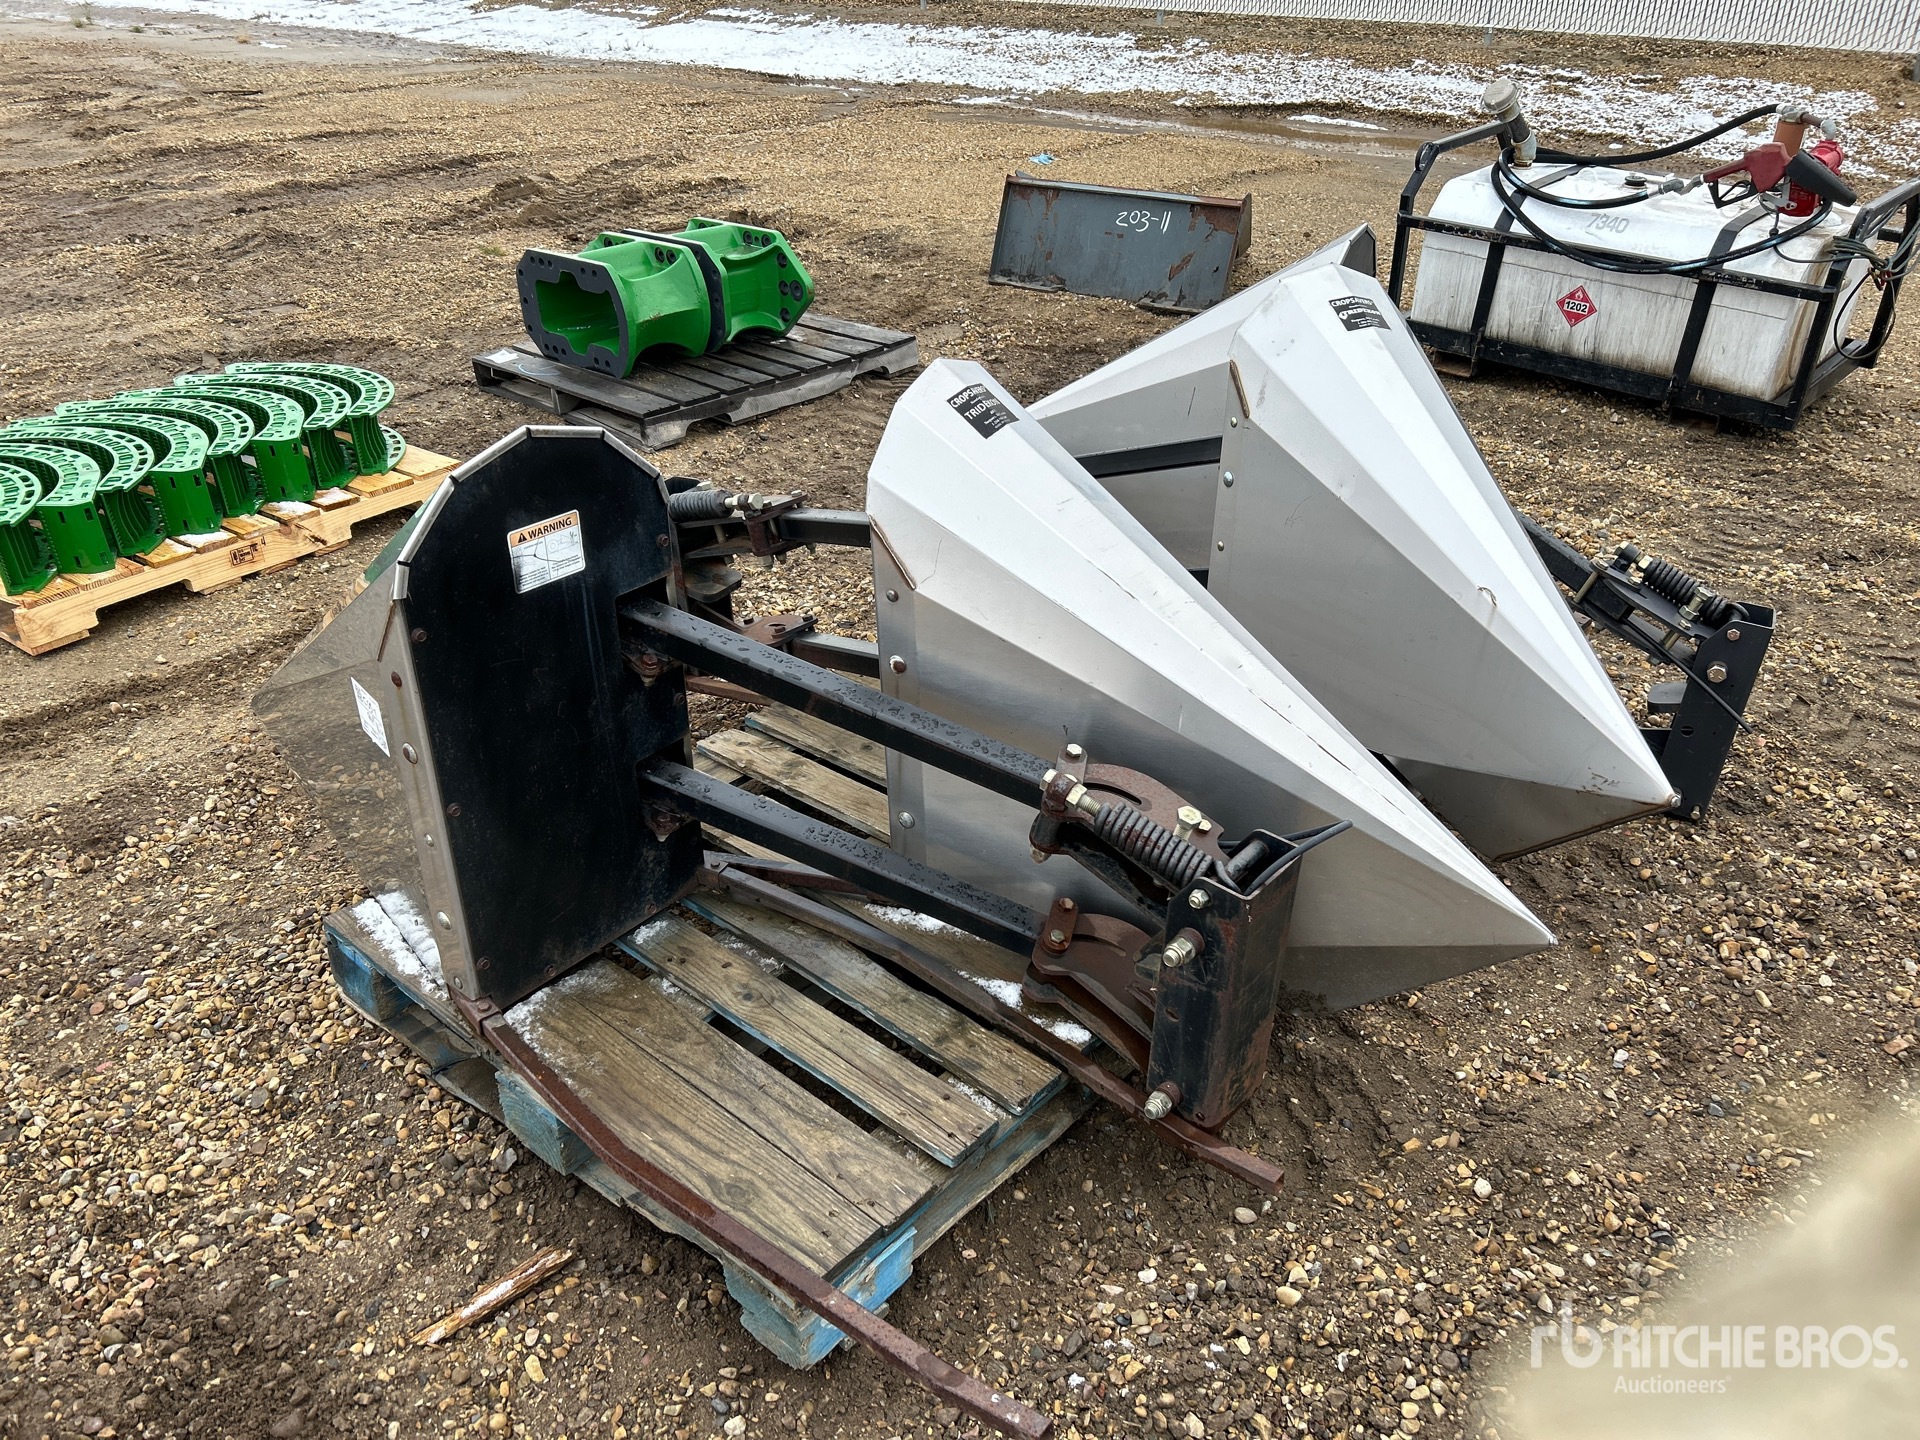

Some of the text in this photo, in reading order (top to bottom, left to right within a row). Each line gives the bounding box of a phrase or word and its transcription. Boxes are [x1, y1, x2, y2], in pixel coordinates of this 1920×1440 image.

[1115, 210, 1172, 235] 203-11
[1586, 212, 1630, 234] 7340
[1565, 300, 1588, 313] 1202
[528, 517, 572, 540] WARNING
